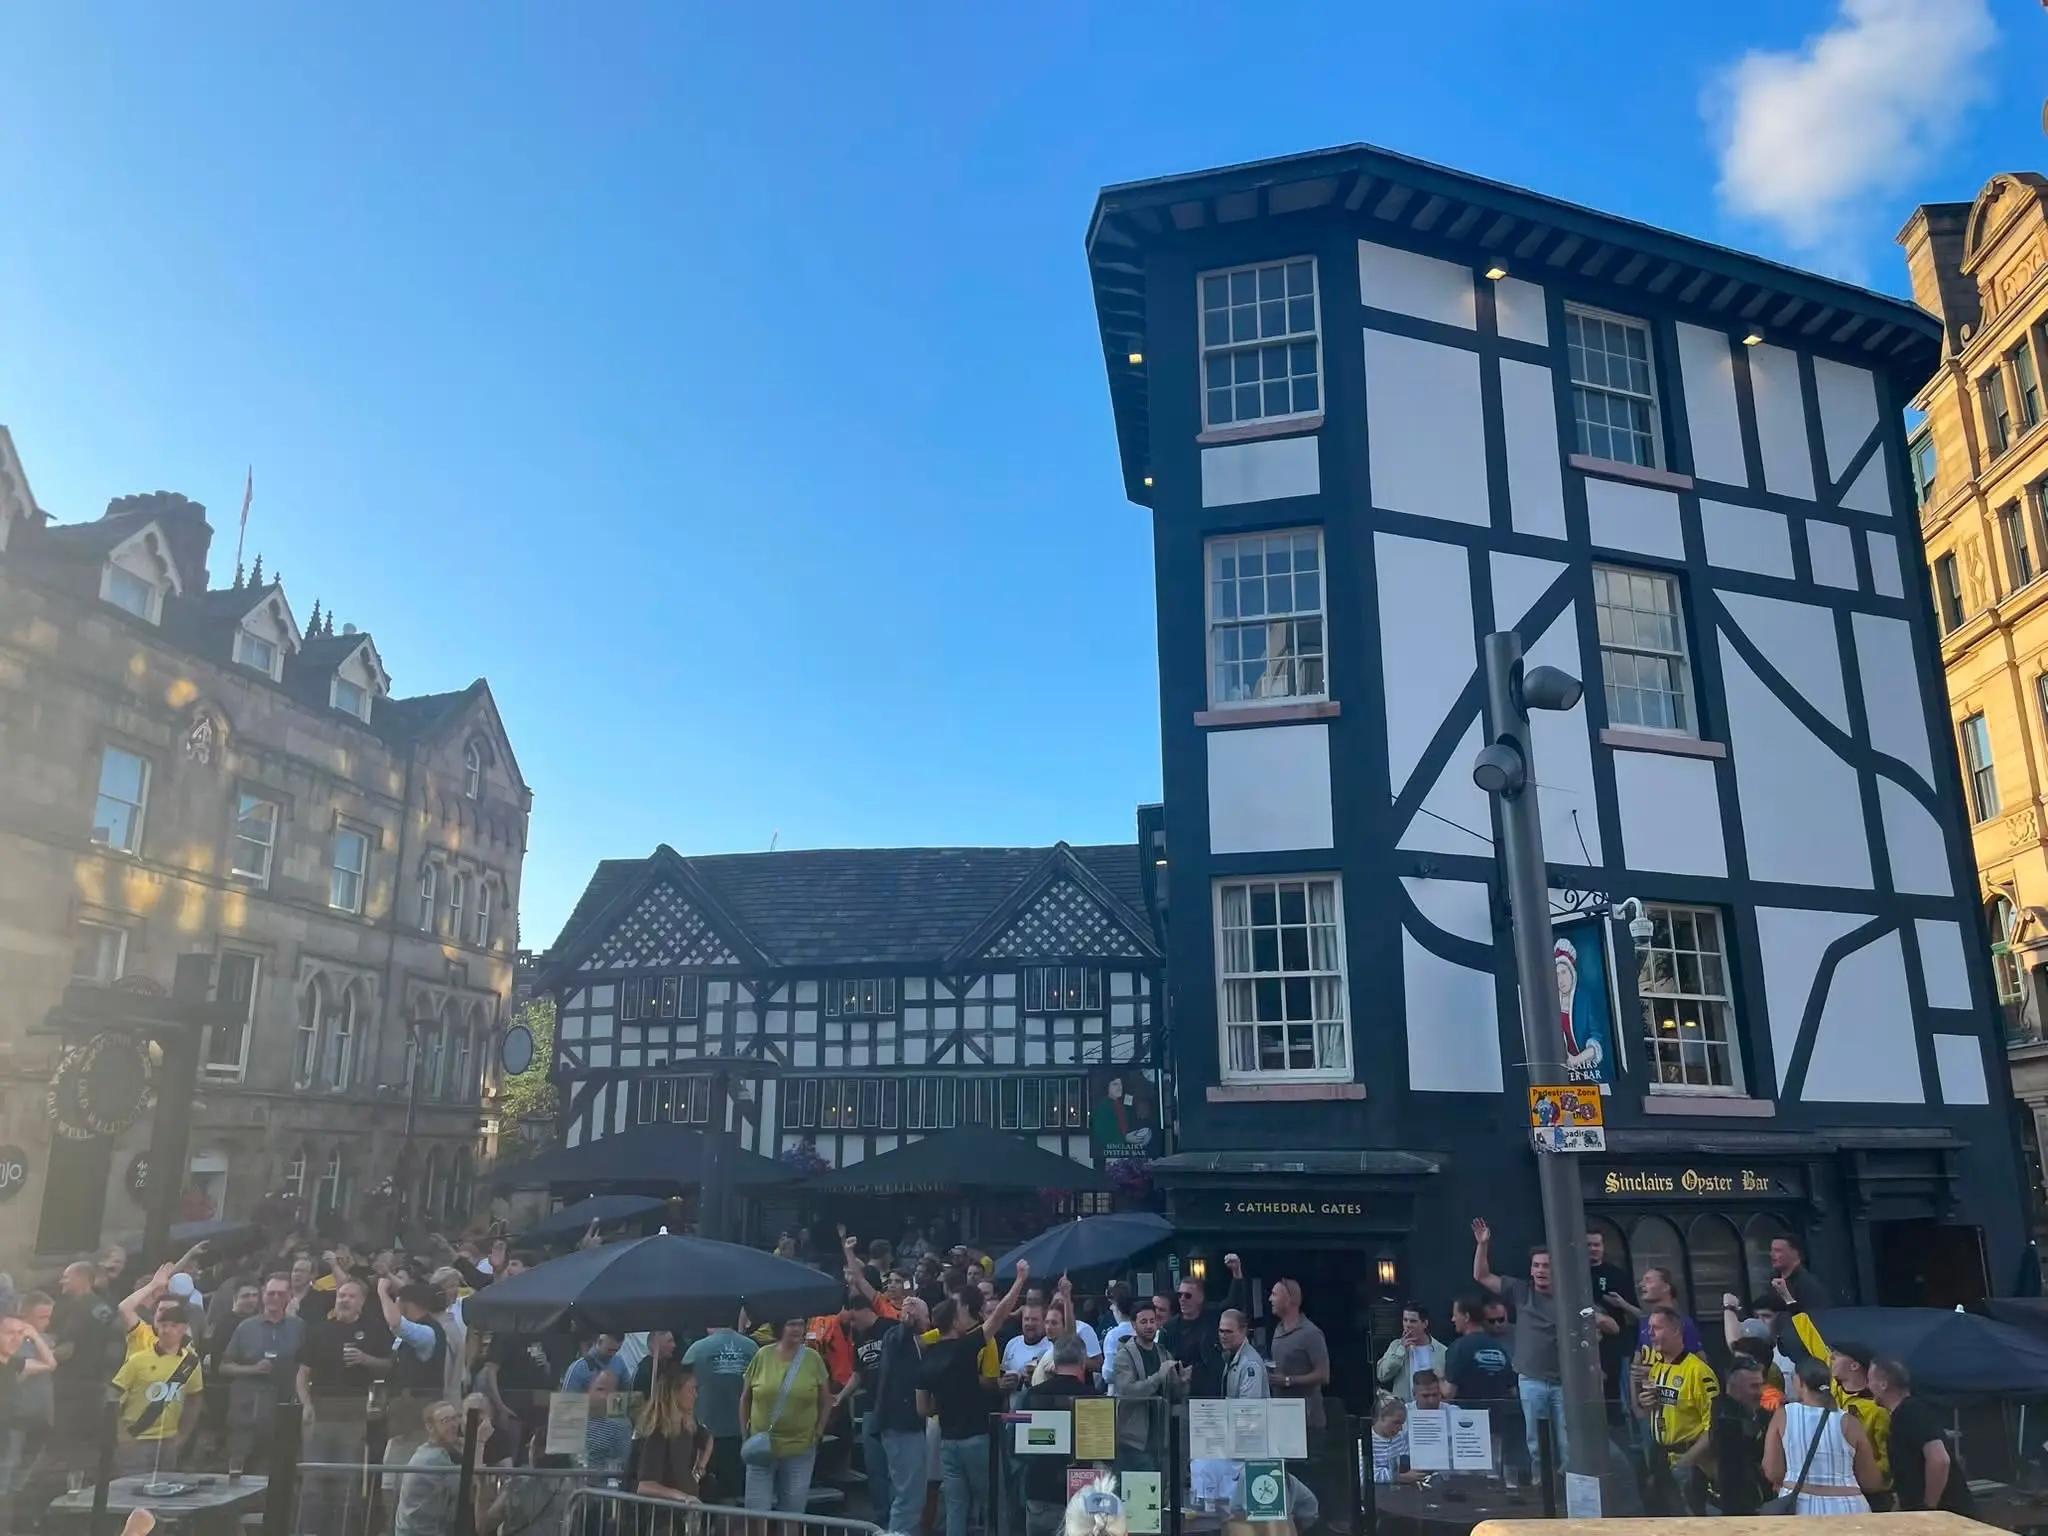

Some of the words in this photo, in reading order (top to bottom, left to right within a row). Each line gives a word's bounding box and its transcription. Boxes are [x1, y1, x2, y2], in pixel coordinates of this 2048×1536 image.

[1583, 1069, 1602, 1080] BAR
[1577, 1087, 1597, 1096] Zone
[1605, 1170, 1674, 1194] Sinclairs
[1681, 1168, 1733, 1196] Oyster
[1741, 1169, 1769, 1191] Bar
[1224, 1202, 1231, 1212] 2
[1237, 1202, 1315, 1214] CATHEDRAL
[1321, 1203, 1361, 1214] GATES
[1070, 1471, 1095, 1480] UNDER
